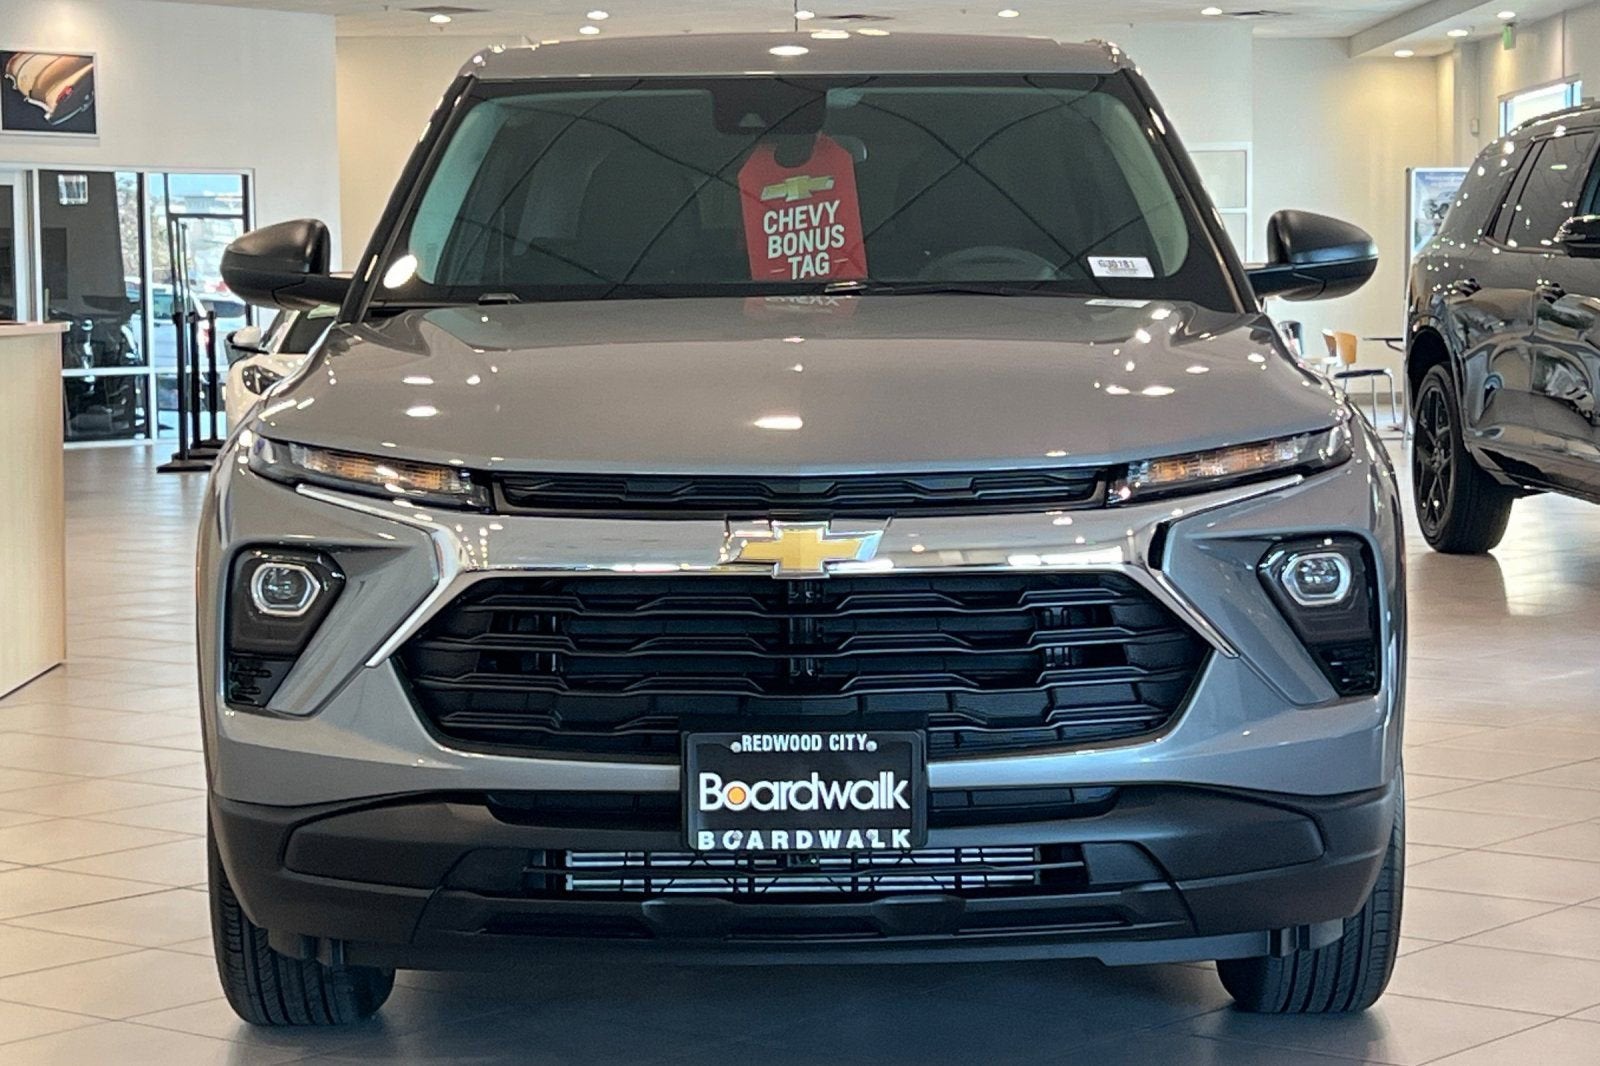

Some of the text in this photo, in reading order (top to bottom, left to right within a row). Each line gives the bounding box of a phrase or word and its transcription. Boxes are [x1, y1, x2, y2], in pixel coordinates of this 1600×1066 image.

[763, 200, 840, 234] CHEVY
[768, 224, 845, 259] BONUS
[788, 252, 830, 280] TAG
[742, 733, 867, 752] REDWOOD CITY
[699, 771, 910, 811] Boardwalk
[698, 829, 911, 850] BOARDWALK
